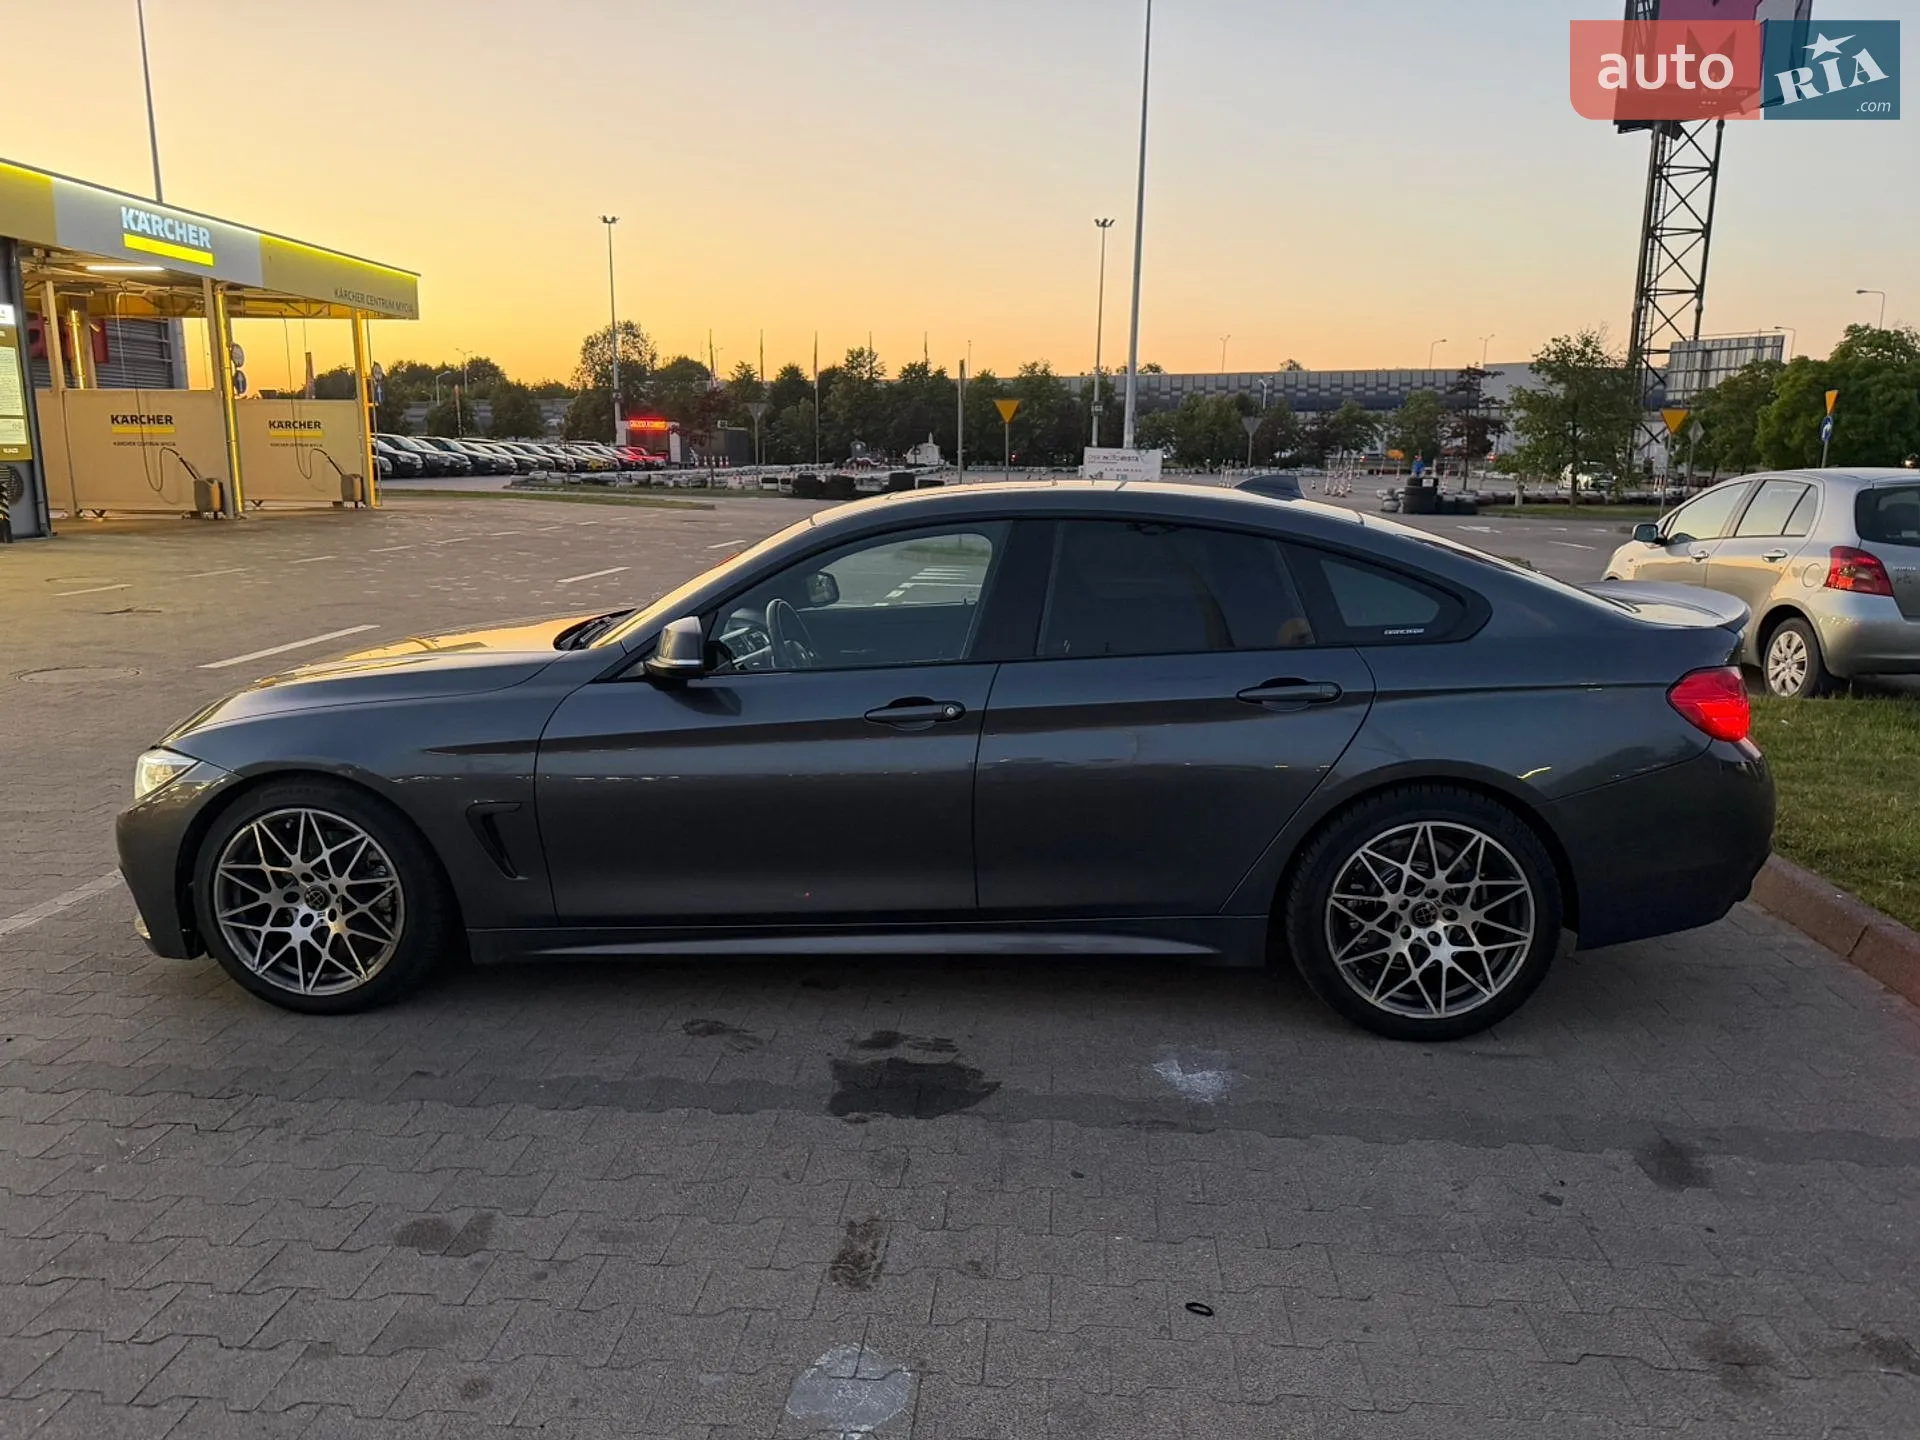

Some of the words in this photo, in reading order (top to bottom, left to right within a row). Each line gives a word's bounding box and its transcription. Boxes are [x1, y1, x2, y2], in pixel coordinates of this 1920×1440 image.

[121, 206, 212, 249] KÄRCHER
[110, 414, 174, 425] KÄRCHER
[268, 420, 322, 430] KÄRCHER
